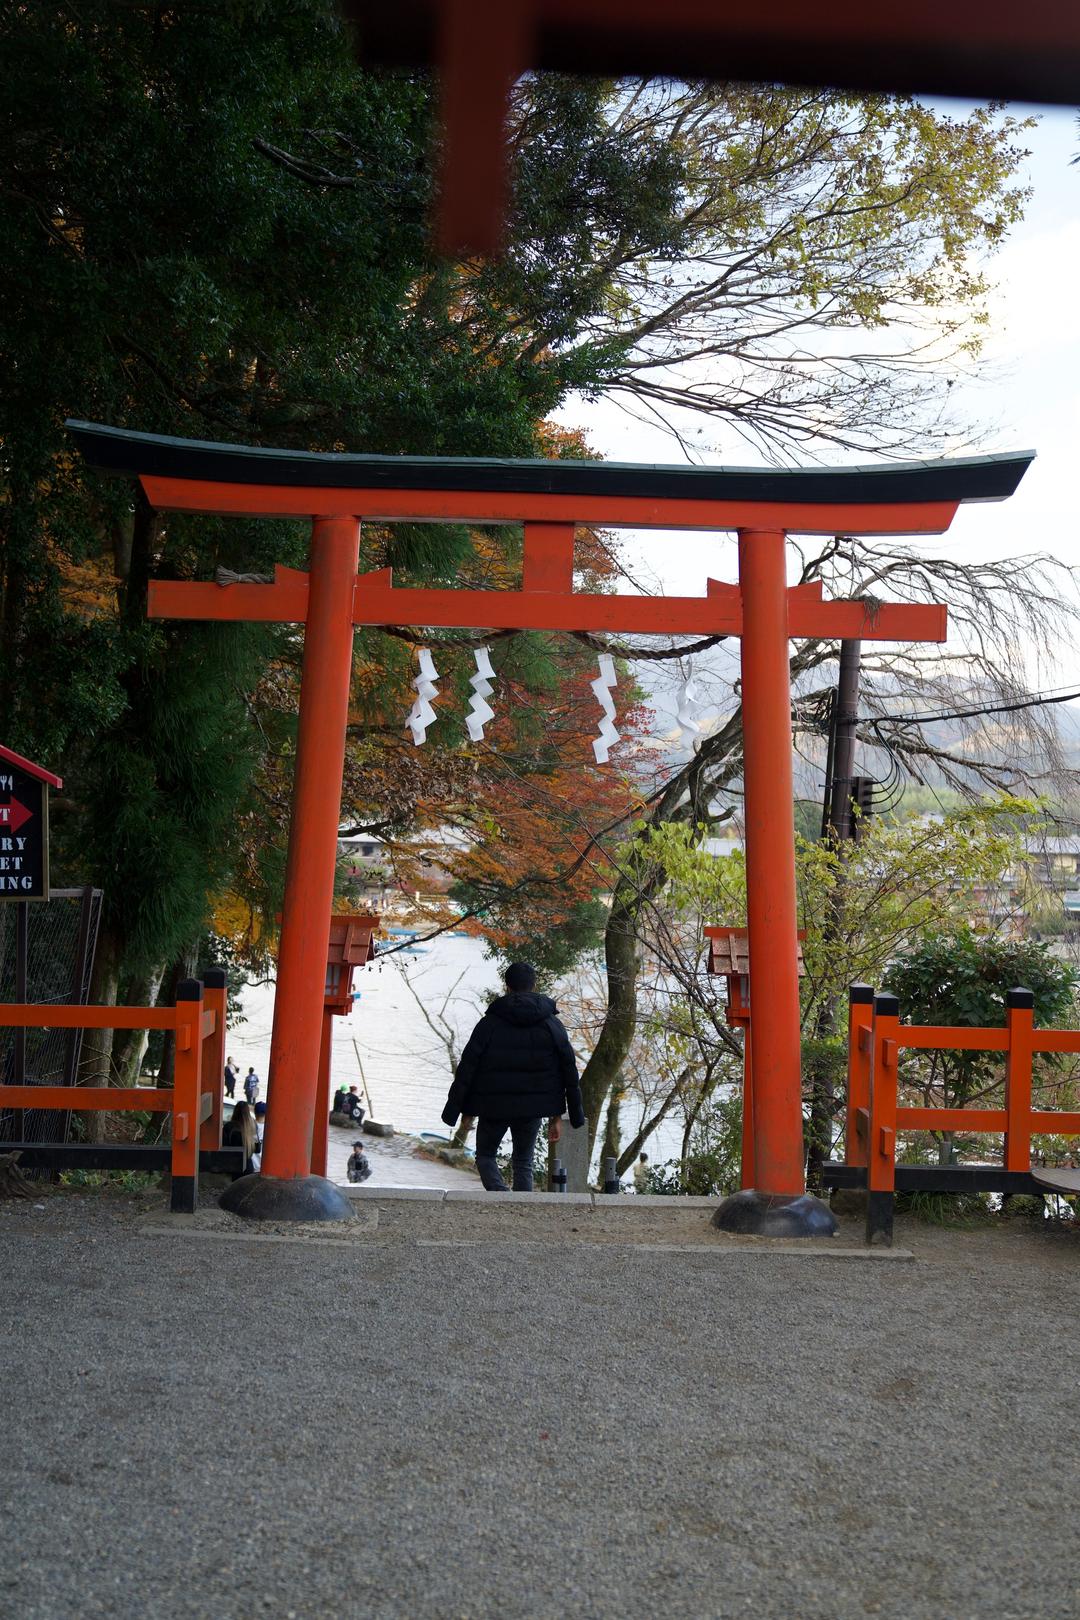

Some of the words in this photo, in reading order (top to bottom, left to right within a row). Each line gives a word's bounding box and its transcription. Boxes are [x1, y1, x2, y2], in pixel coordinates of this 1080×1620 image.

[1, 837, 27, 850] RY
[0, 857, 23, 870] ET
[0, 876, 33, 890] ING
